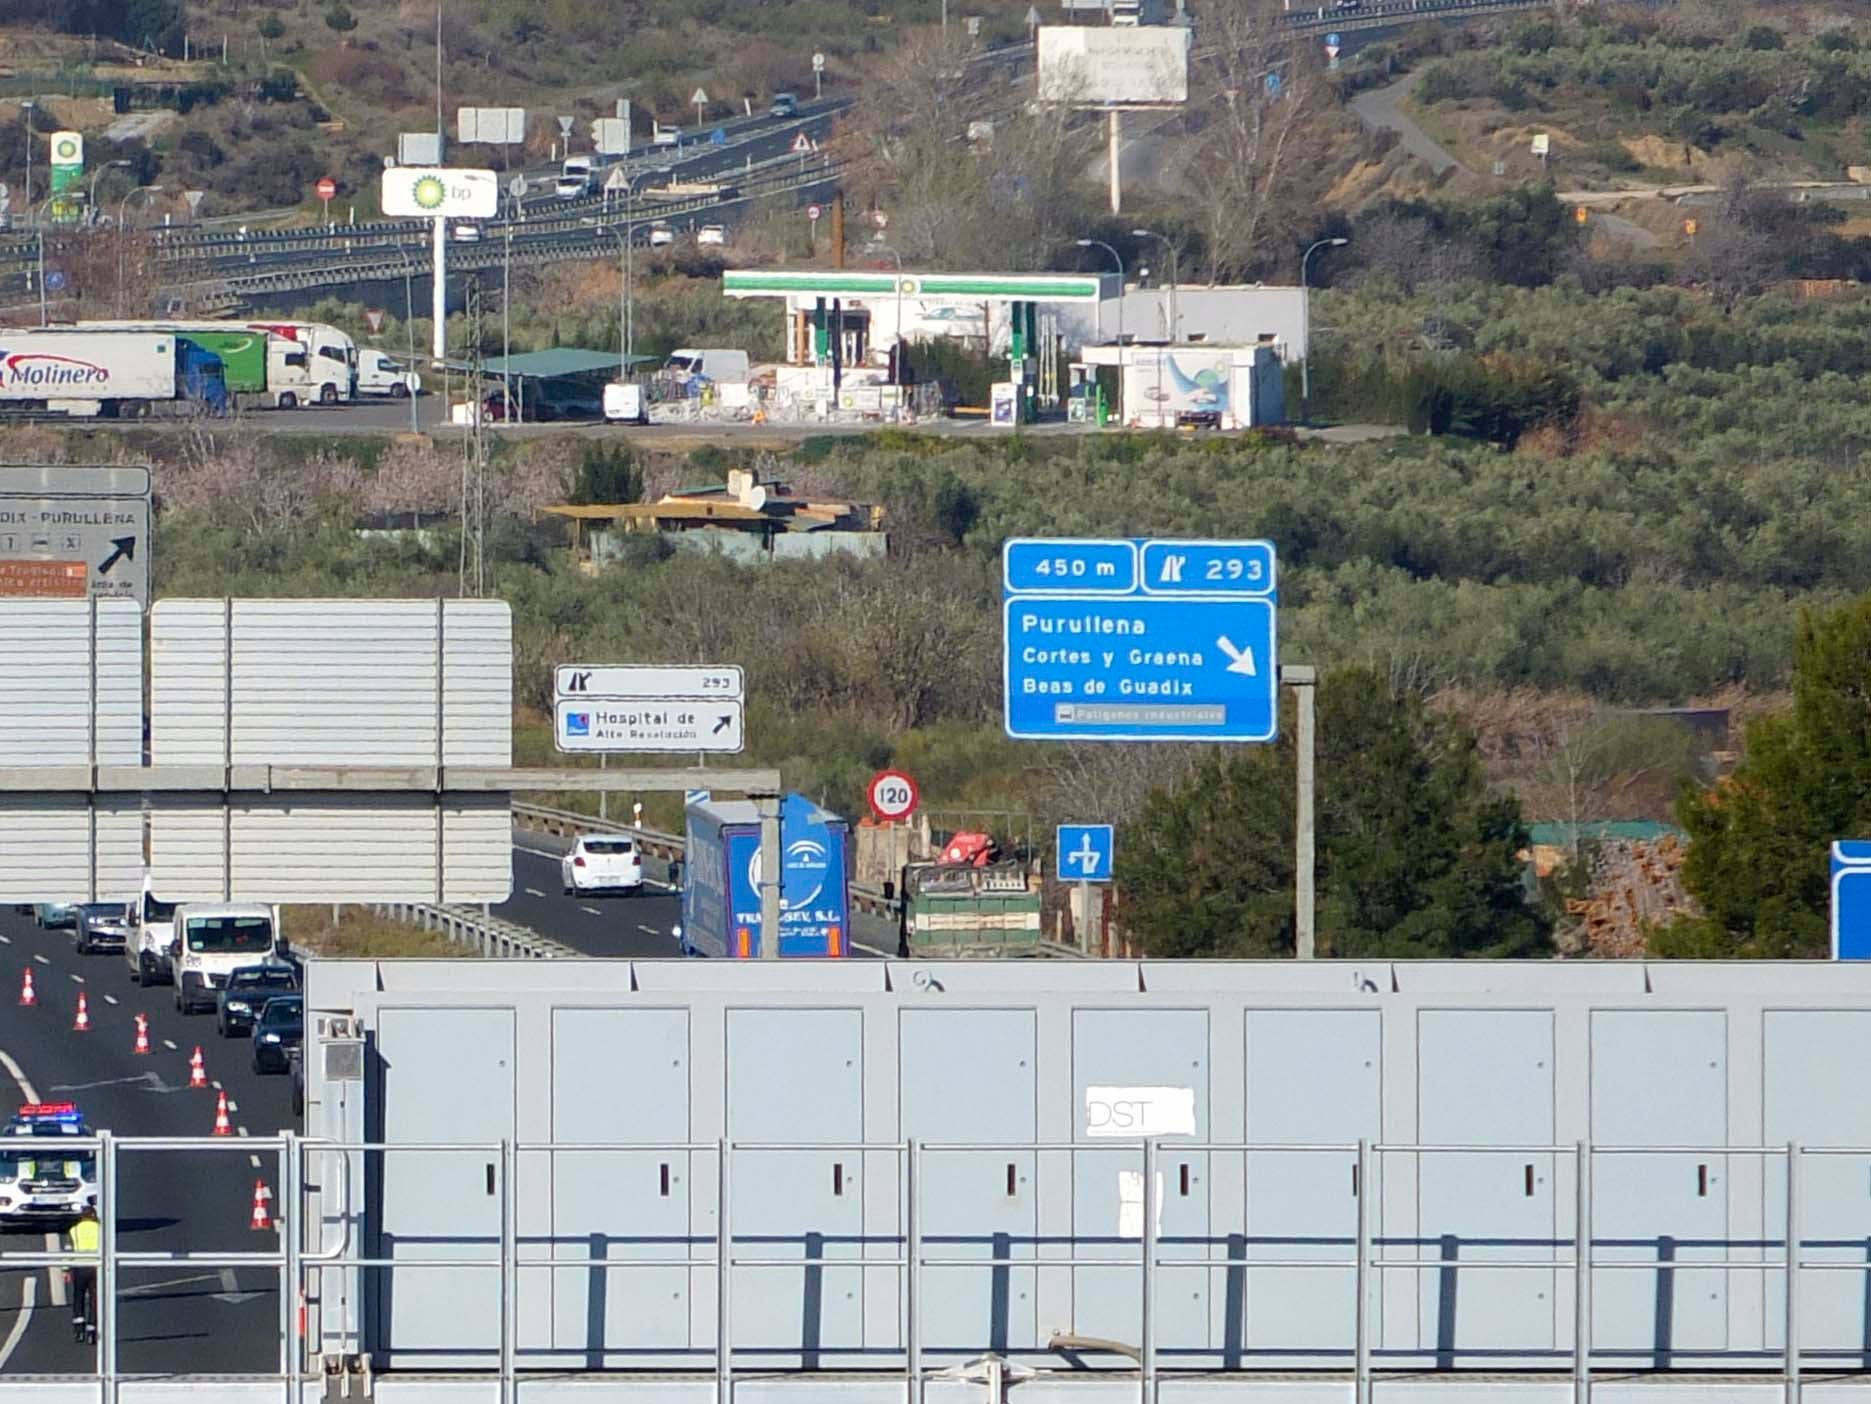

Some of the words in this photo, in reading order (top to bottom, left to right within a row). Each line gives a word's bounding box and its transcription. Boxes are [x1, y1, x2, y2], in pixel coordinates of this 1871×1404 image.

[10, 364, 110, 385] Molinero
[41, 511, 136, 525] PURULLENA
[1035, 559, 1086, 576] 450
[1097, 562, 1115, 576] m
[1206, 560, 1263, 580] 293
[1022, 614, 1146, 635] Purullena
[1023, 647, 1091, 664] Cortes
[1102, 650, 1114, 668] y
[1129, 649, 1203, 666] Graena
[1023, 678, 1073, 694] Beas
[1084, 679, 1106, 693] de
[1119, 680, 1193, 696] Guadix
[596, 712, 667, 726] Hospital
[678, 713, 695, 724] de
[880, 787, 908, 804] 120
[1087, 1101, 1153, 1128] DST
